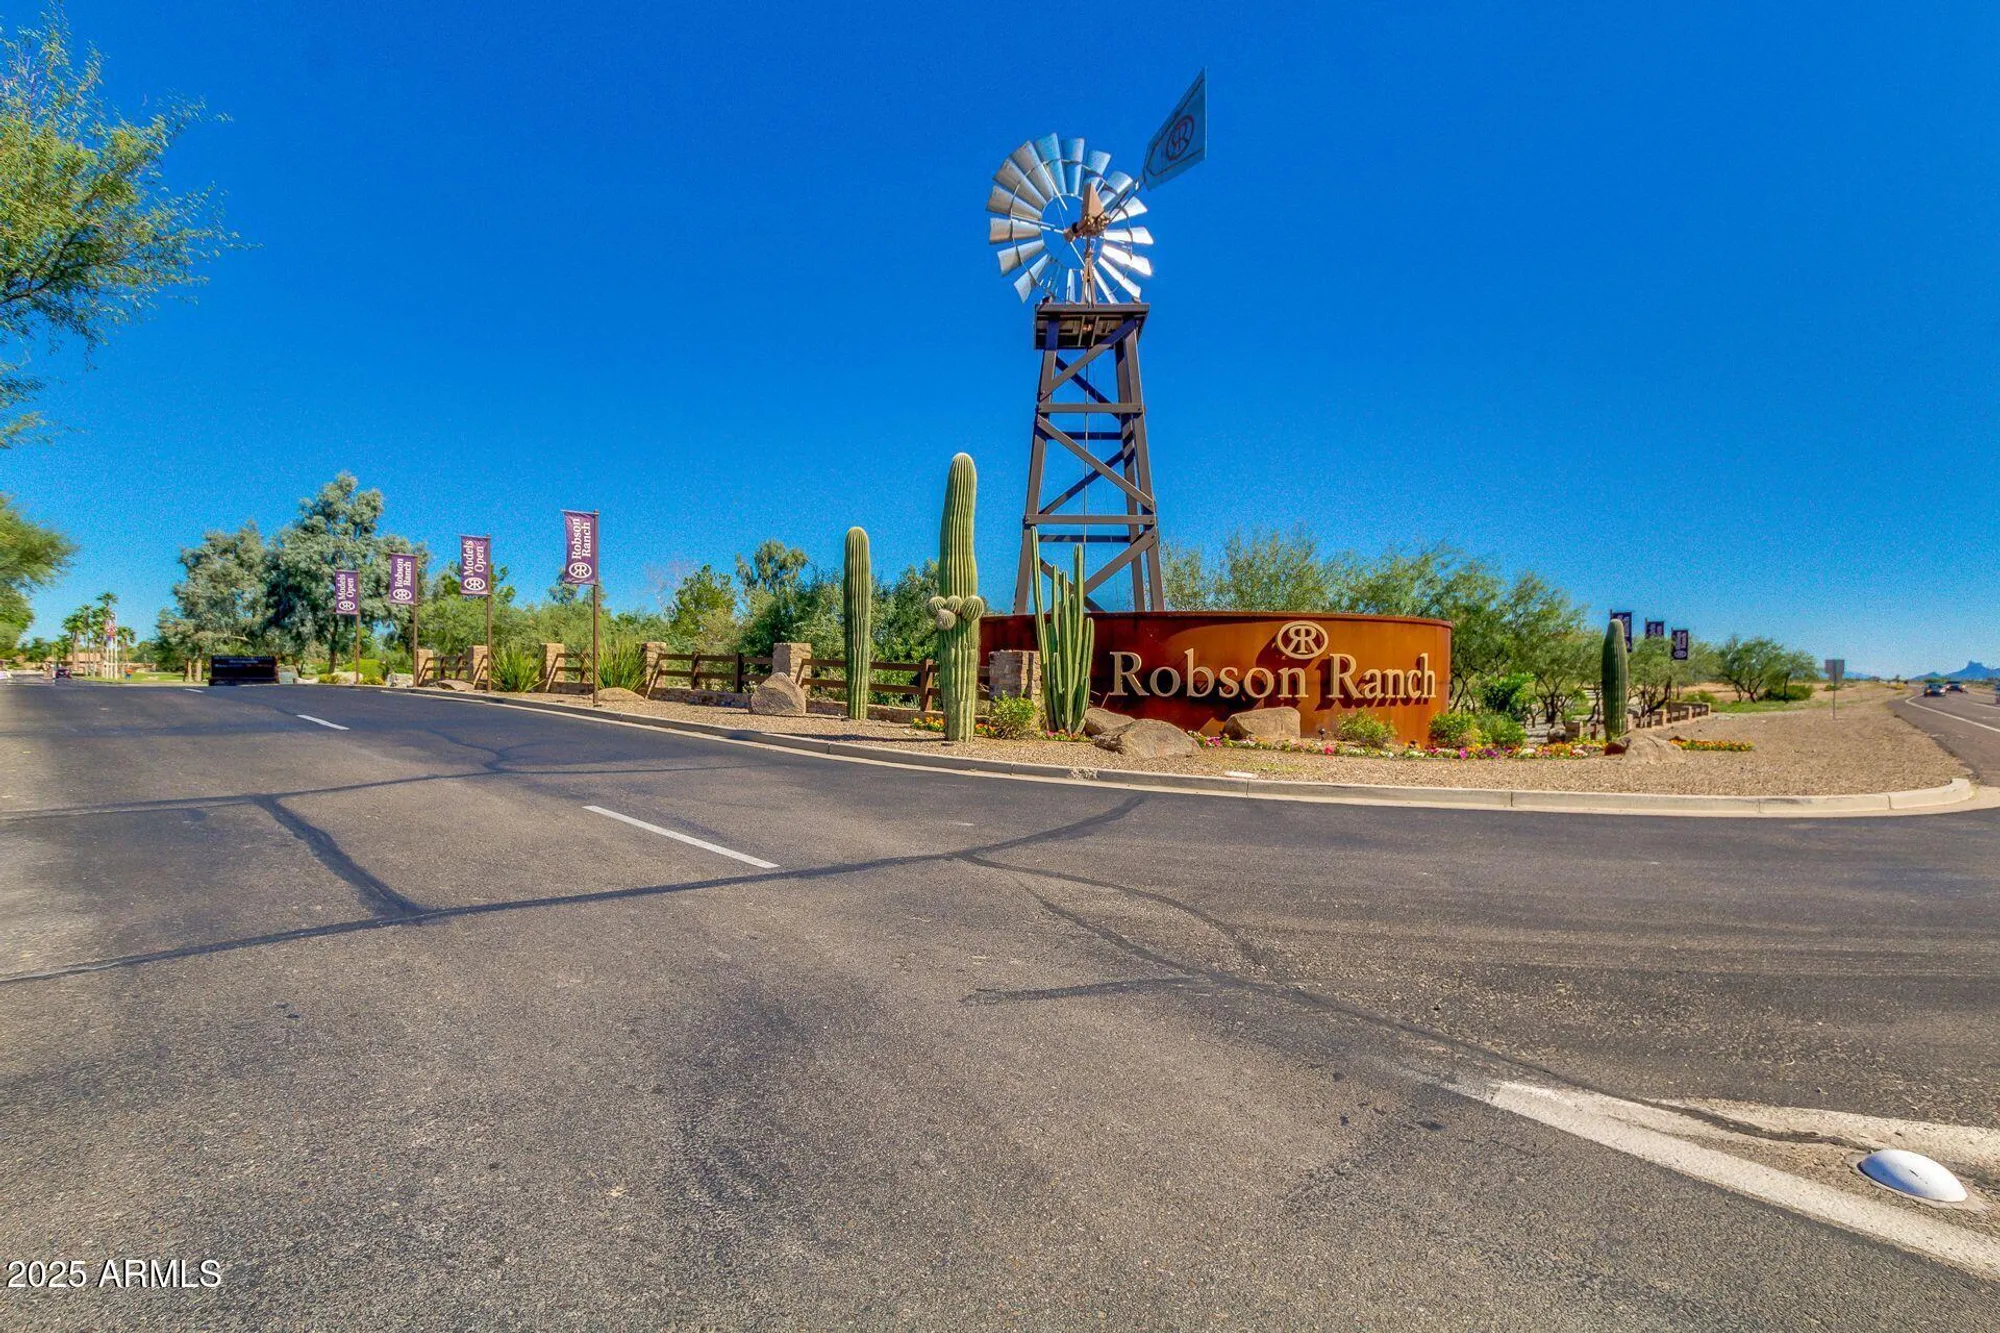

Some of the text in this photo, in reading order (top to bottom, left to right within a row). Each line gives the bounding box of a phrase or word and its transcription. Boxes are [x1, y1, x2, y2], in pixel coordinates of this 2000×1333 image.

[571, 518, 582, 560] Robson
[581, 522, 592, 557] Ranch
[463, 540, 474, 576] Models
[475, 545, 487, 573] Open
[1109, 648, 1436, 699] Robson Ranch
